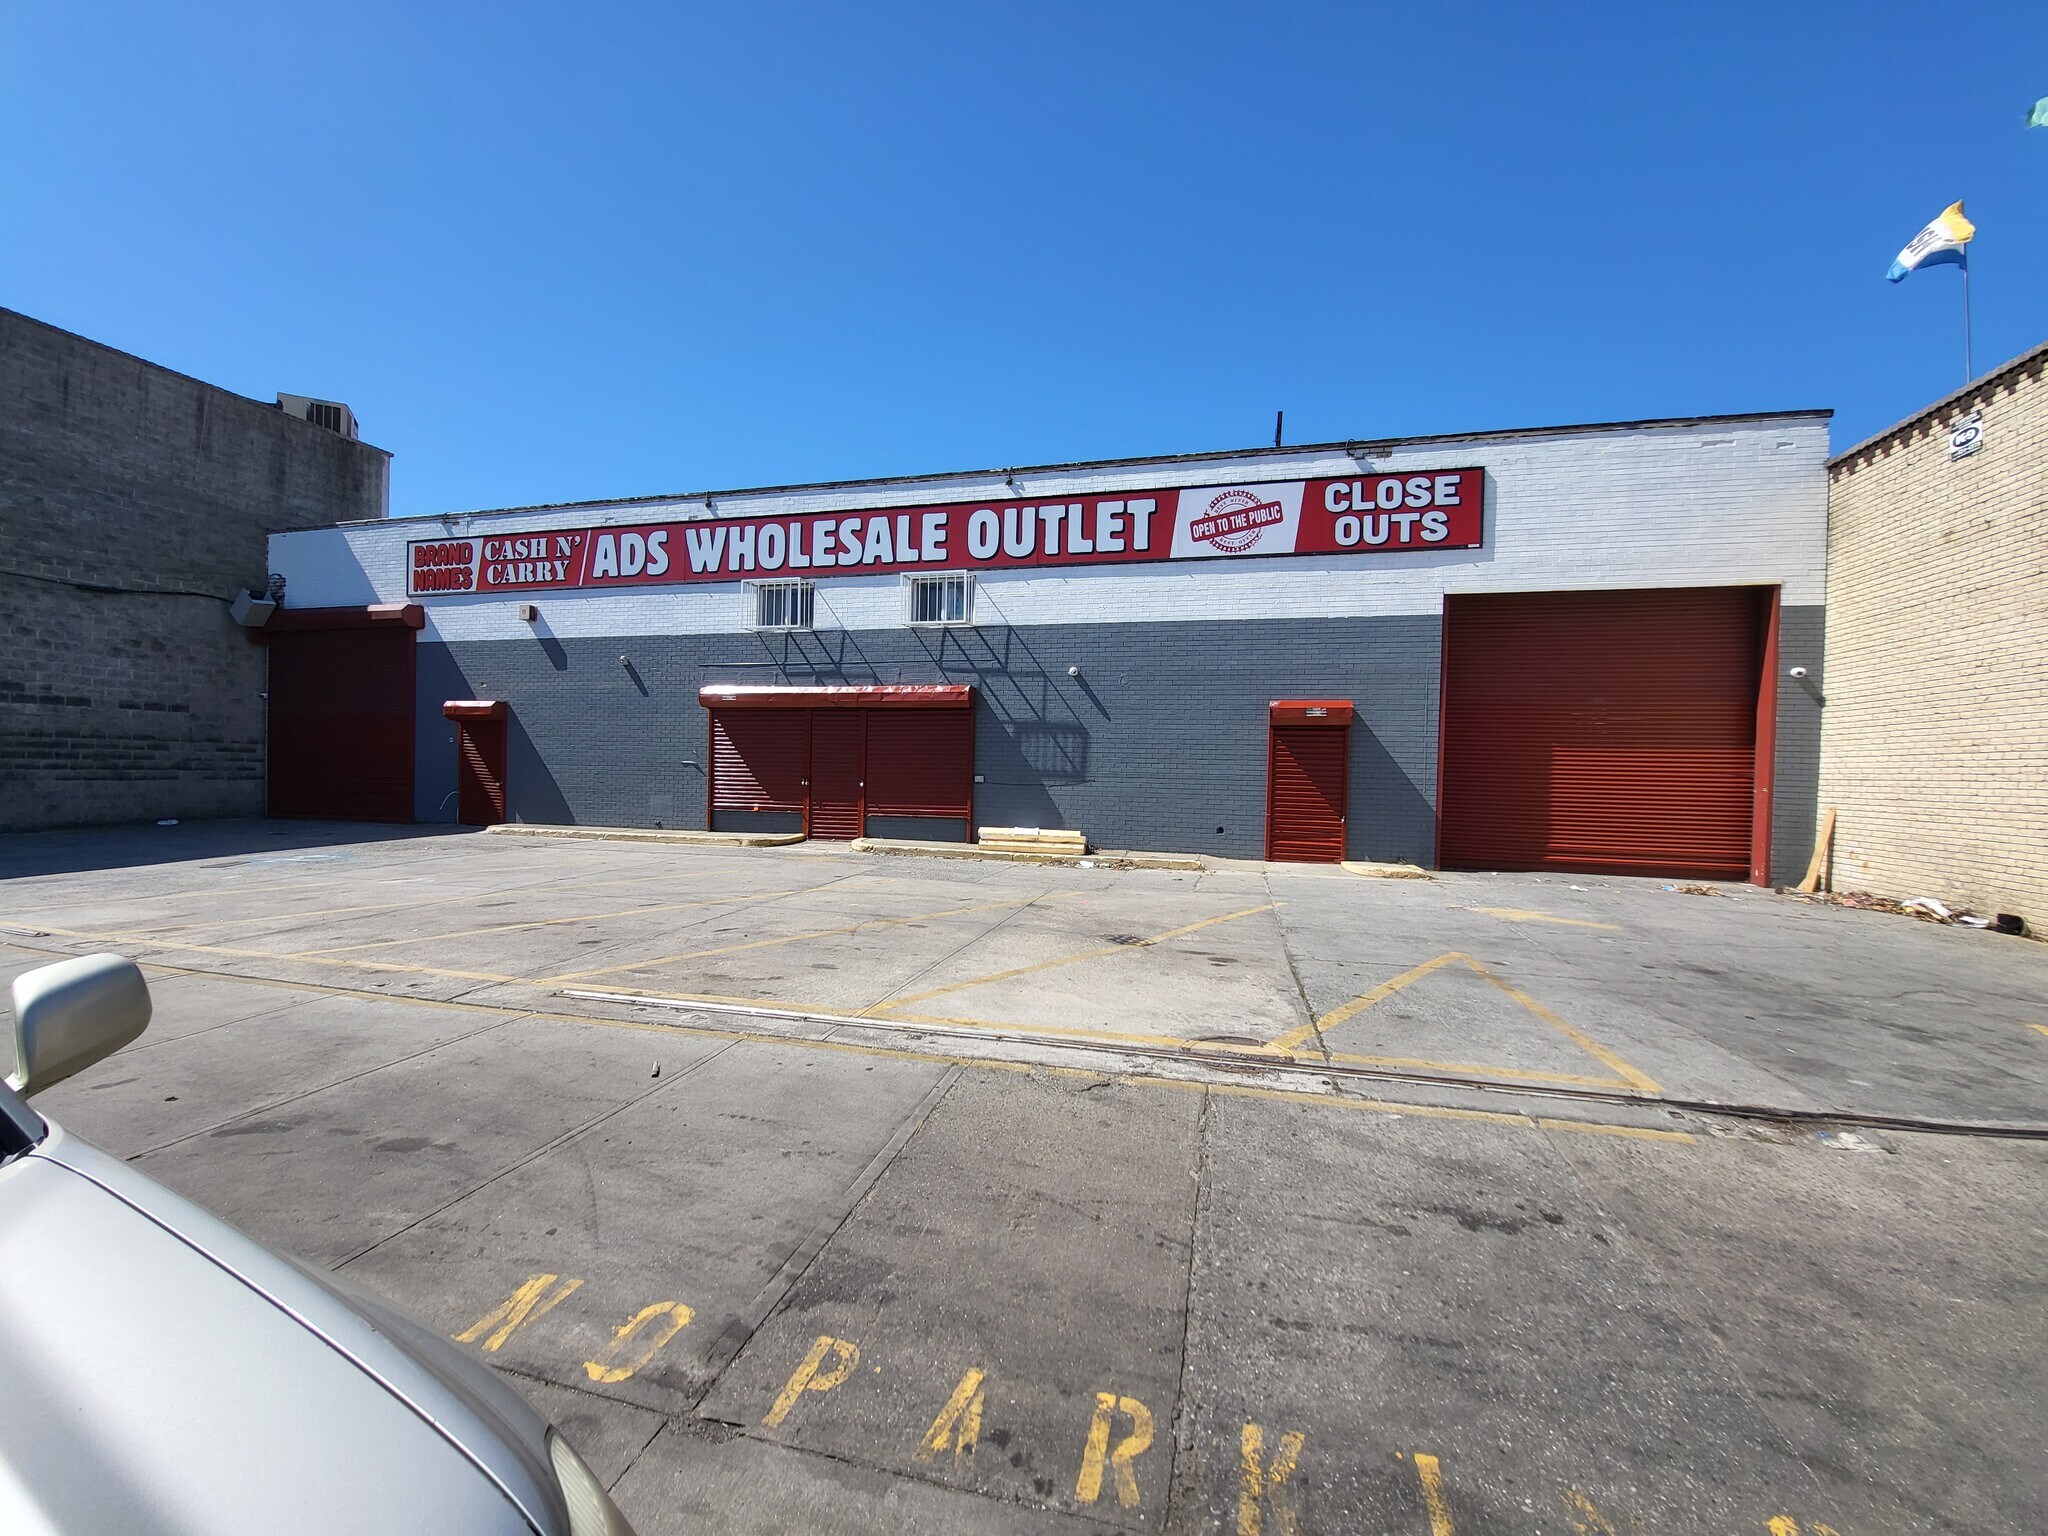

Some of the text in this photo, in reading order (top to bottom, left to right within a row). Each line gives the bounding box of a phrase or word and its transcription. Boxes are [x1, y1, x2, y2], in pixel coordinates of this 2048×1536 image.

[1324, 475, 1461, 513] CLOSE
[1192, 505, 1281, 538] OPEN TO THE PUBLIC
[1334, 511, 1449, 547] OUTS
[414, 542, 473, 567] BRAND
[484, 536, 581, 562] CASH N'
[592, 499, 1156, 579] ADS WHOLESALE OUTLET
[413, 566, 474, 591] NAMES
[486, 560, 570, 584] CARRY
[452, 1273, 696, 1384] NO
